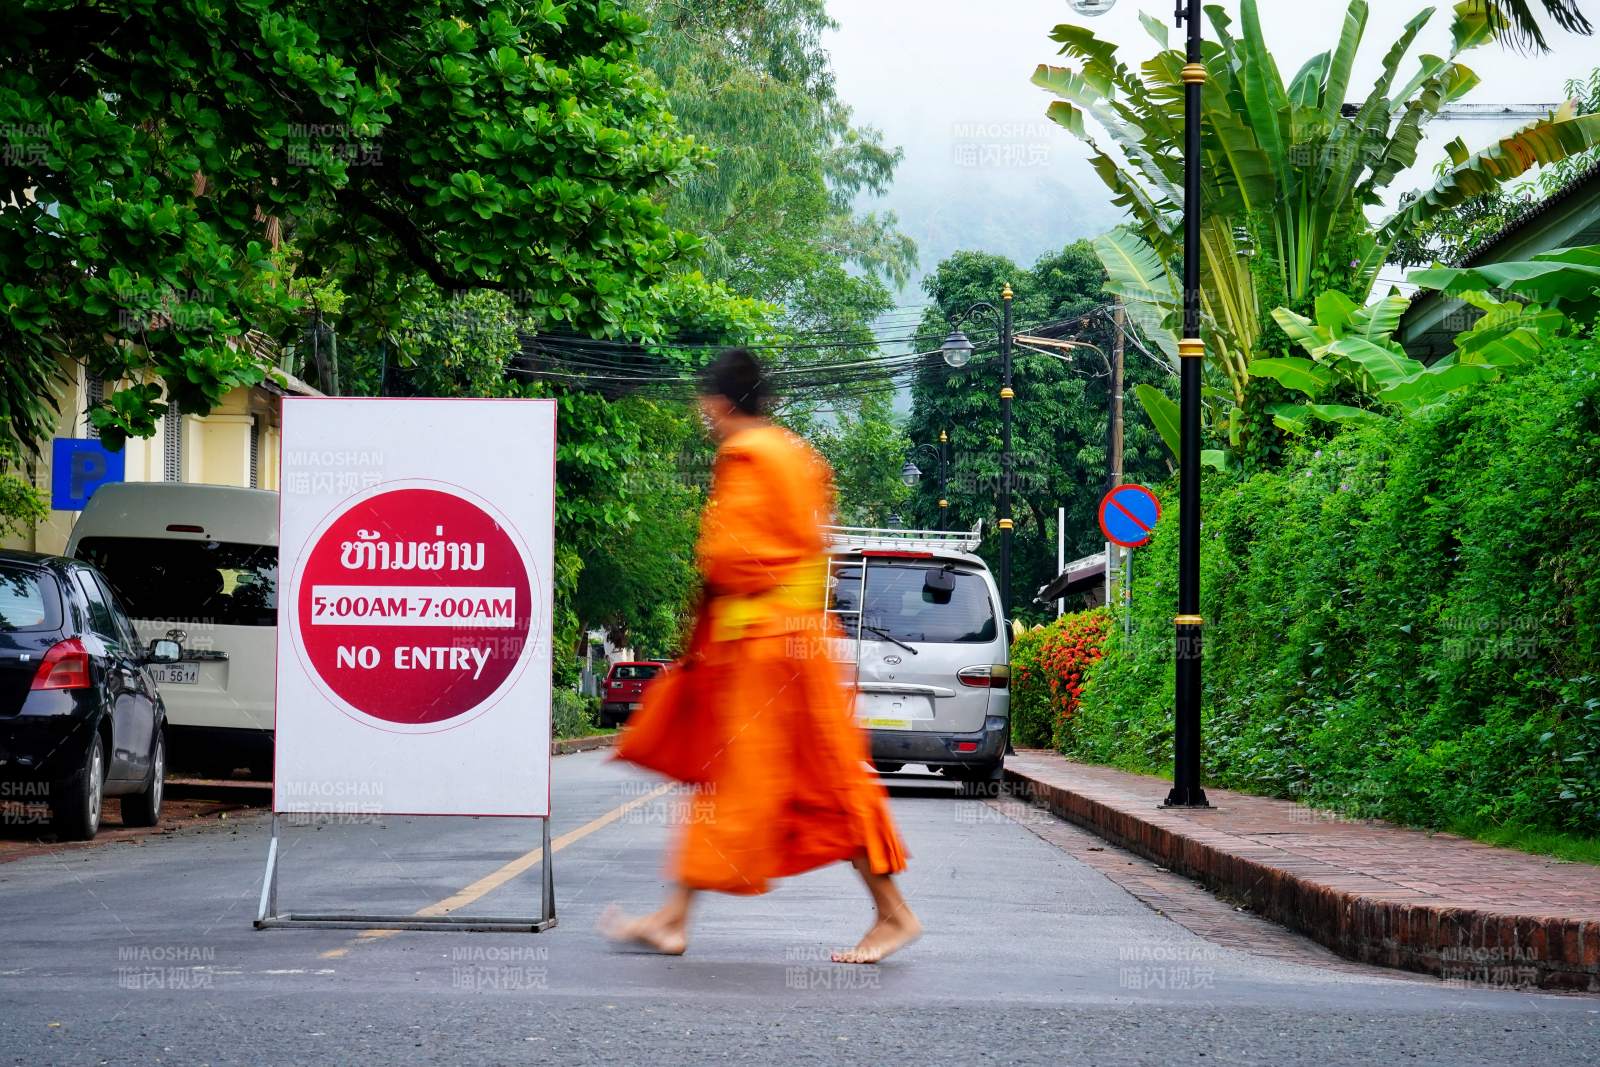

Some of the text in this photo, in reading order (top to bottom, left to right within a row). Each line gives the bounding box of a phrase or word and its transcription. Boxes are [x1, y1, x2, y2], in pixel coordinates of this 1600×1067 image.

[70, 452, 107, 499] P
[340, 525, 485, 571] ຫ້າມຜ່ານ
[314, 596, 512, 618] 5:00AM-7:00AM
[170, 670, 195, 682] 5614
[336, 645, 491, 680] NO ENTRY
